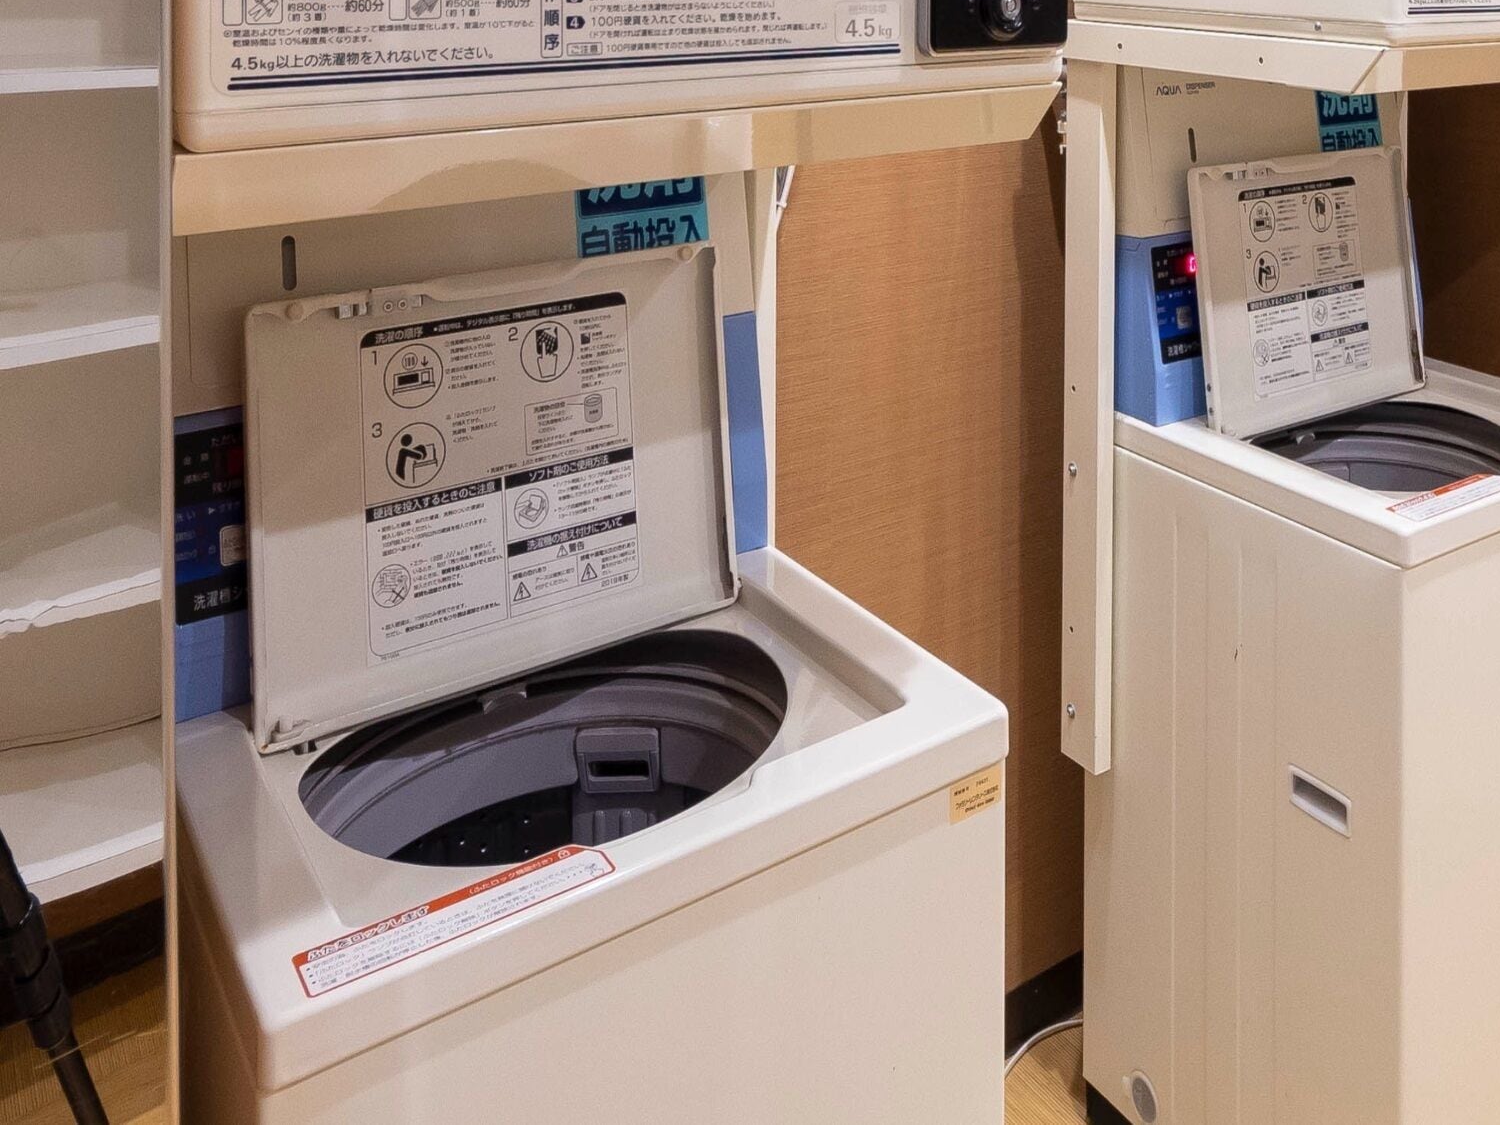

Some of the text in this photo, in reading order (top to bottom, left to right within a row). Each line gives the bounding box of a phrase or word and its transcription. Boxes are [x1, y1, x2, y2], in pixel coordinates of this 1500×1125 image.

[344, 0, 384, 13] 約60分
[569, 17, 579, 28] 4
[845, 18, 892, 38] 4.5 kg
[231, 47, 494, 72] 4.5kg以上の洗濯物を入れないでください。
[1156, 83, 1182, 96] AQUA
[1321, 128, 1379, 152] 自動投入
[582, 213, 701, 258] 自動投入
[375, 327, 424, 344] 洗濯の順序
[508, 326, 519, 342] 2
[371, 350, 378, 366] 1
[371, 422, 383, 439] 3
[569, 541, 585, 553] 警告
[308, 906, 430, 961] ふたをロックします
